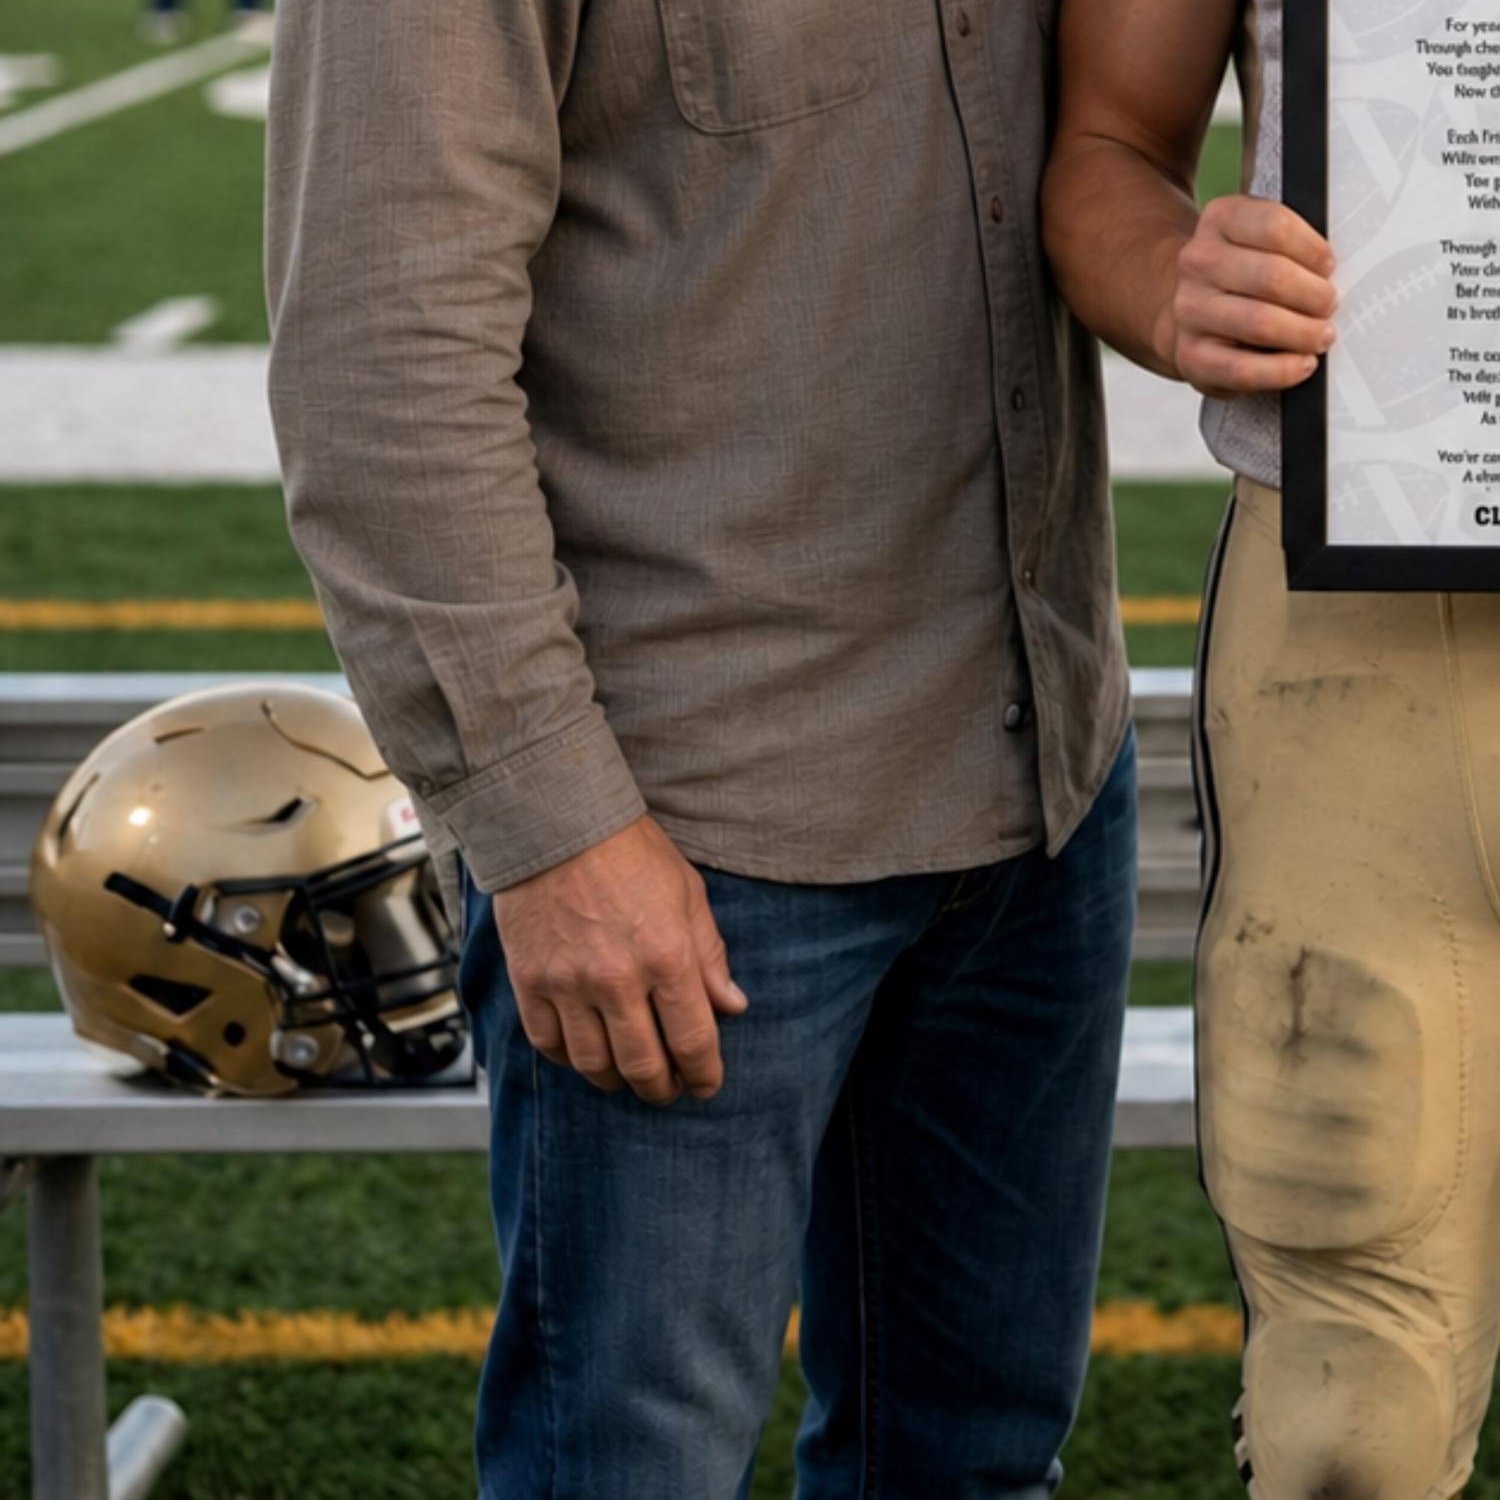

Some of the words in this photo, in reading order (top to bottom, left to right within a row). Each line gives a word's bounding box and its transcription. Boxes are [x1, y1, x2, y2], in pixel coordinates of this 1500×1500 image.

[1446, 17, 1468, 32] For
[1455, 84, 1486, 98] Now
[1462, 470, 1473, 483] A
